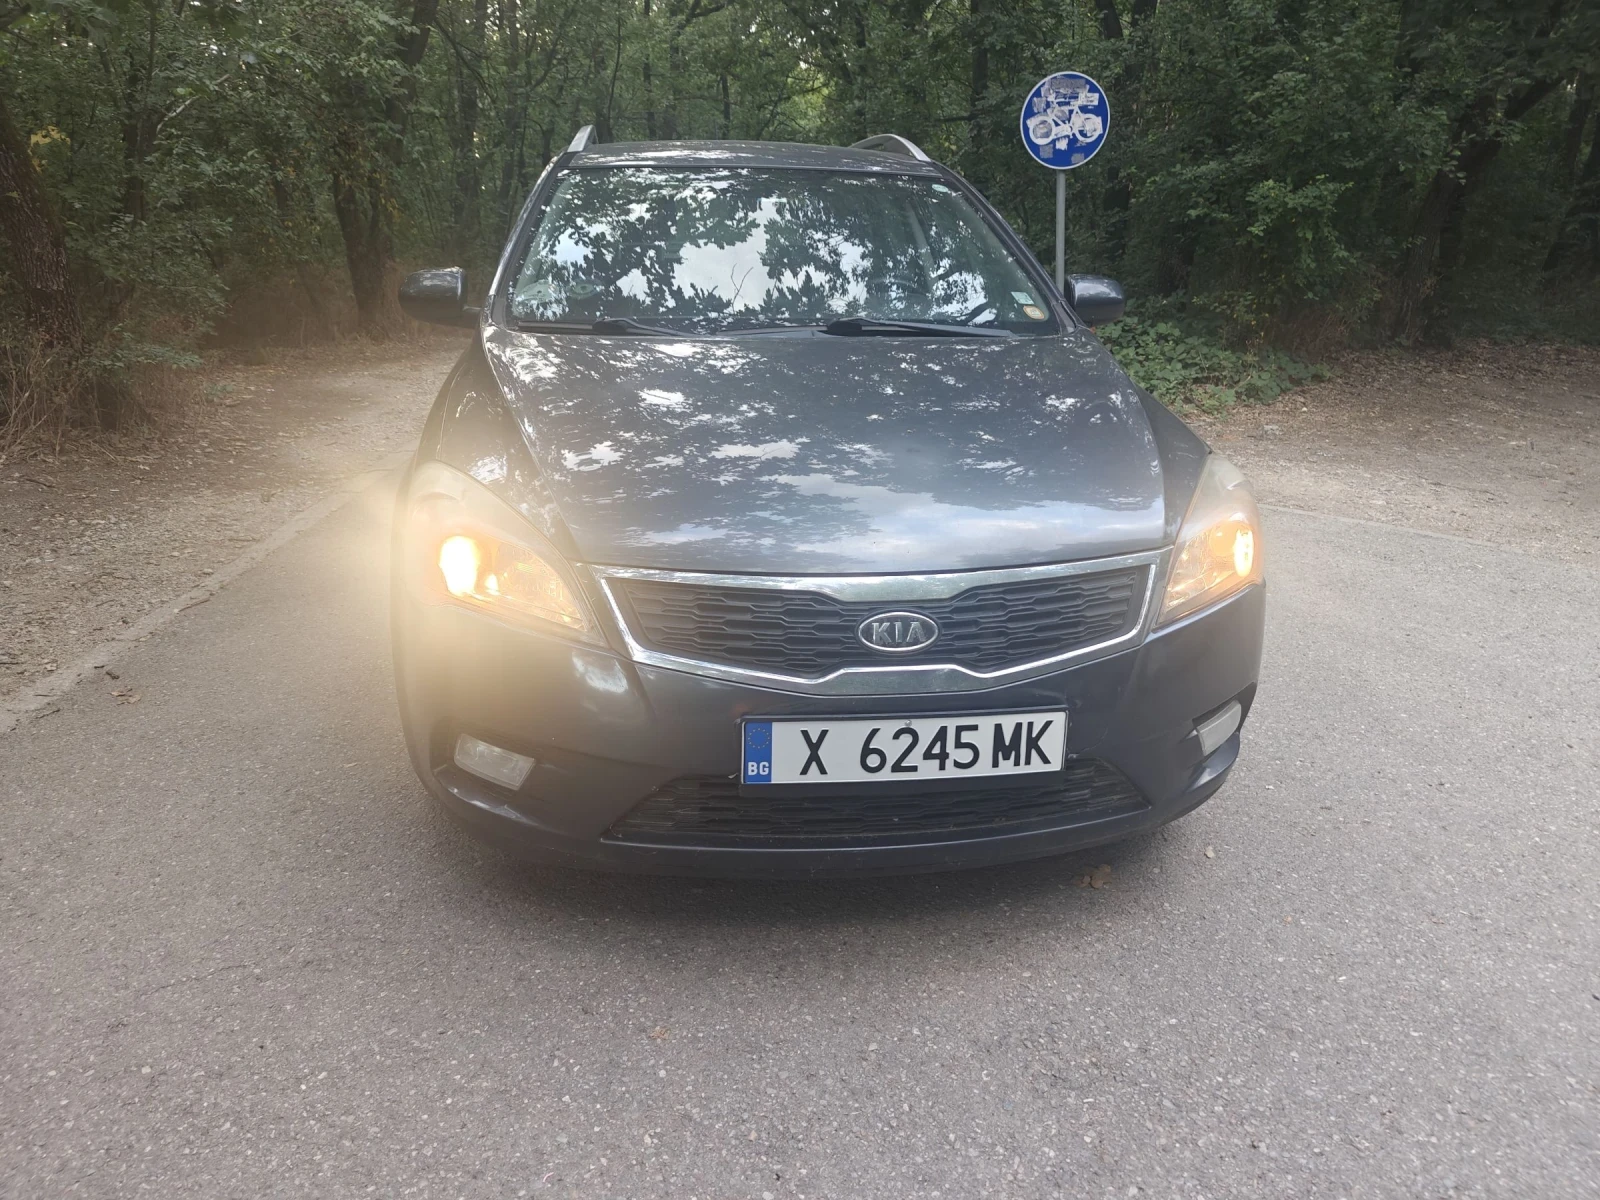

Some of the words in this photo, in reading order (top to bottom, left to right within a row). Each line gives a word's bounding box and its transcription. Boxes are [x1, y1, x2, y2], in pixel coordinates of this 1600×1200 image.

[871, 621, 926, 644] KIA
[799, 728, 829, 776] X
[859, 724, 980, 774] 6245
[991, 719, 1055, 769] MK
[747, 761, 770, 776] BG
